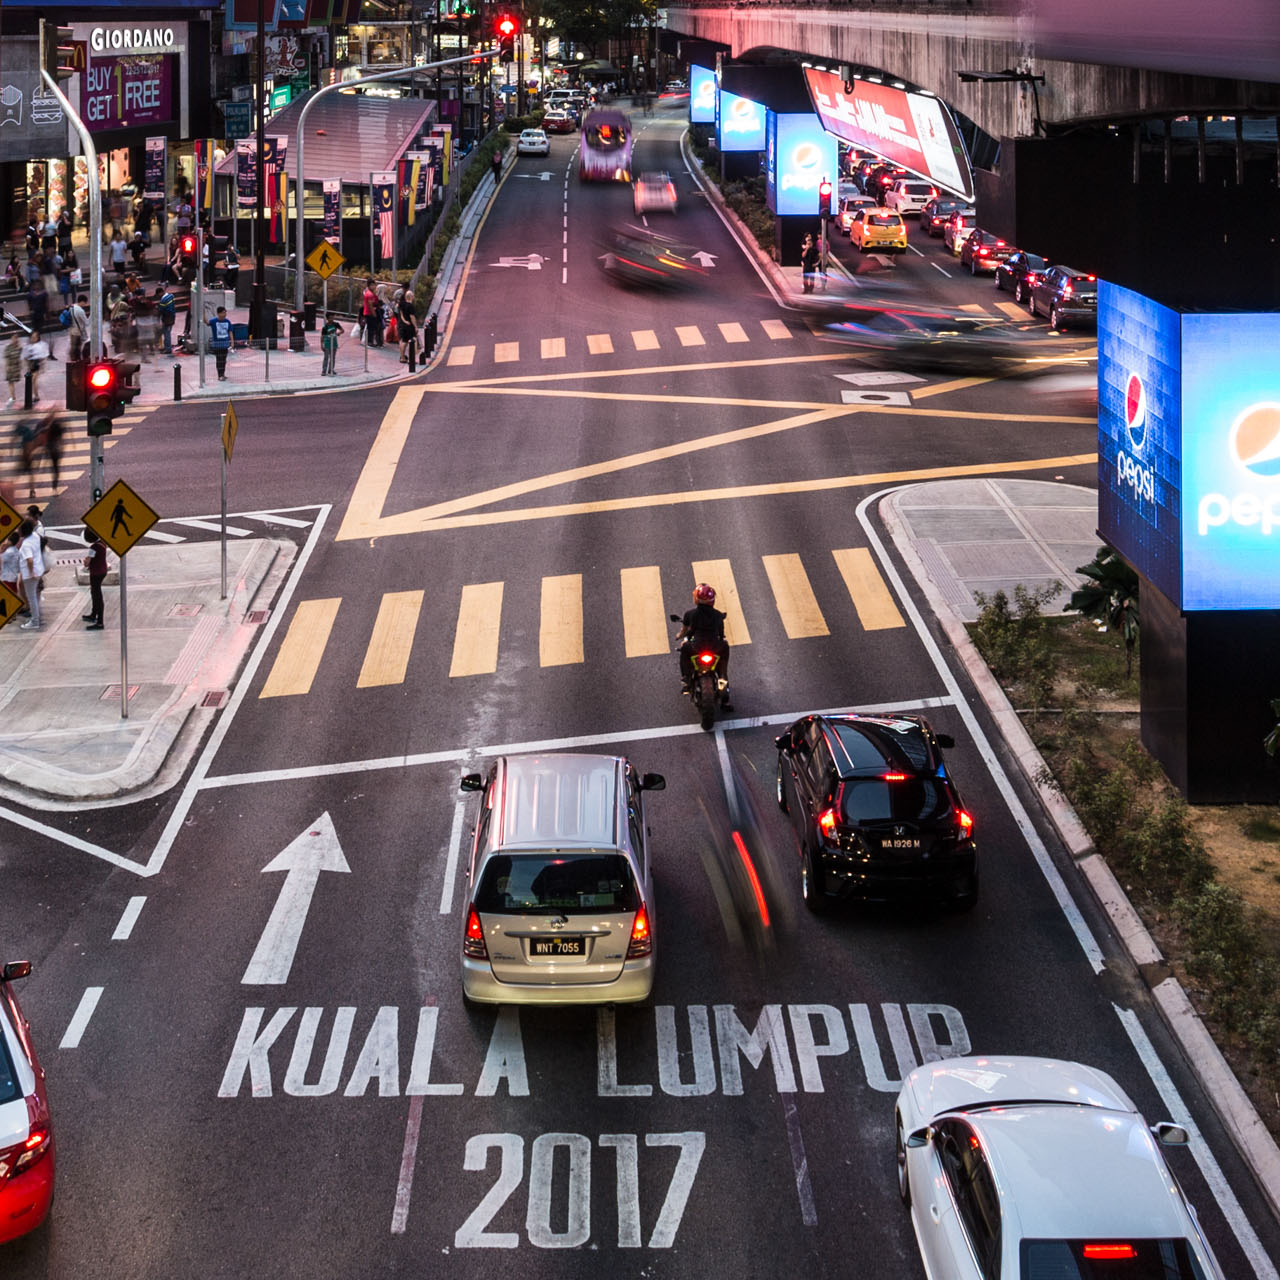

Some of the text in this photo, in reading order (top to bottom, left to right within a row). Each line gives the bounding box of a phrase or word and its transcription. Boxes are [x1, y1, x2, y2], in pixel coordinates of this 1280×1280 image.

[91, 28, 174, 52] GIORDANO
[87, 66, 112, 92] BUY
[87, 80, 160, 122] GET FREE
[1117, 450, 1155, 504] pepsi
[536, 942, 580, 953] WNT 7055
[218, 1003, 972, 1098] KUALA LUMPUR
[454, 1131, 706, 1249] 2017
